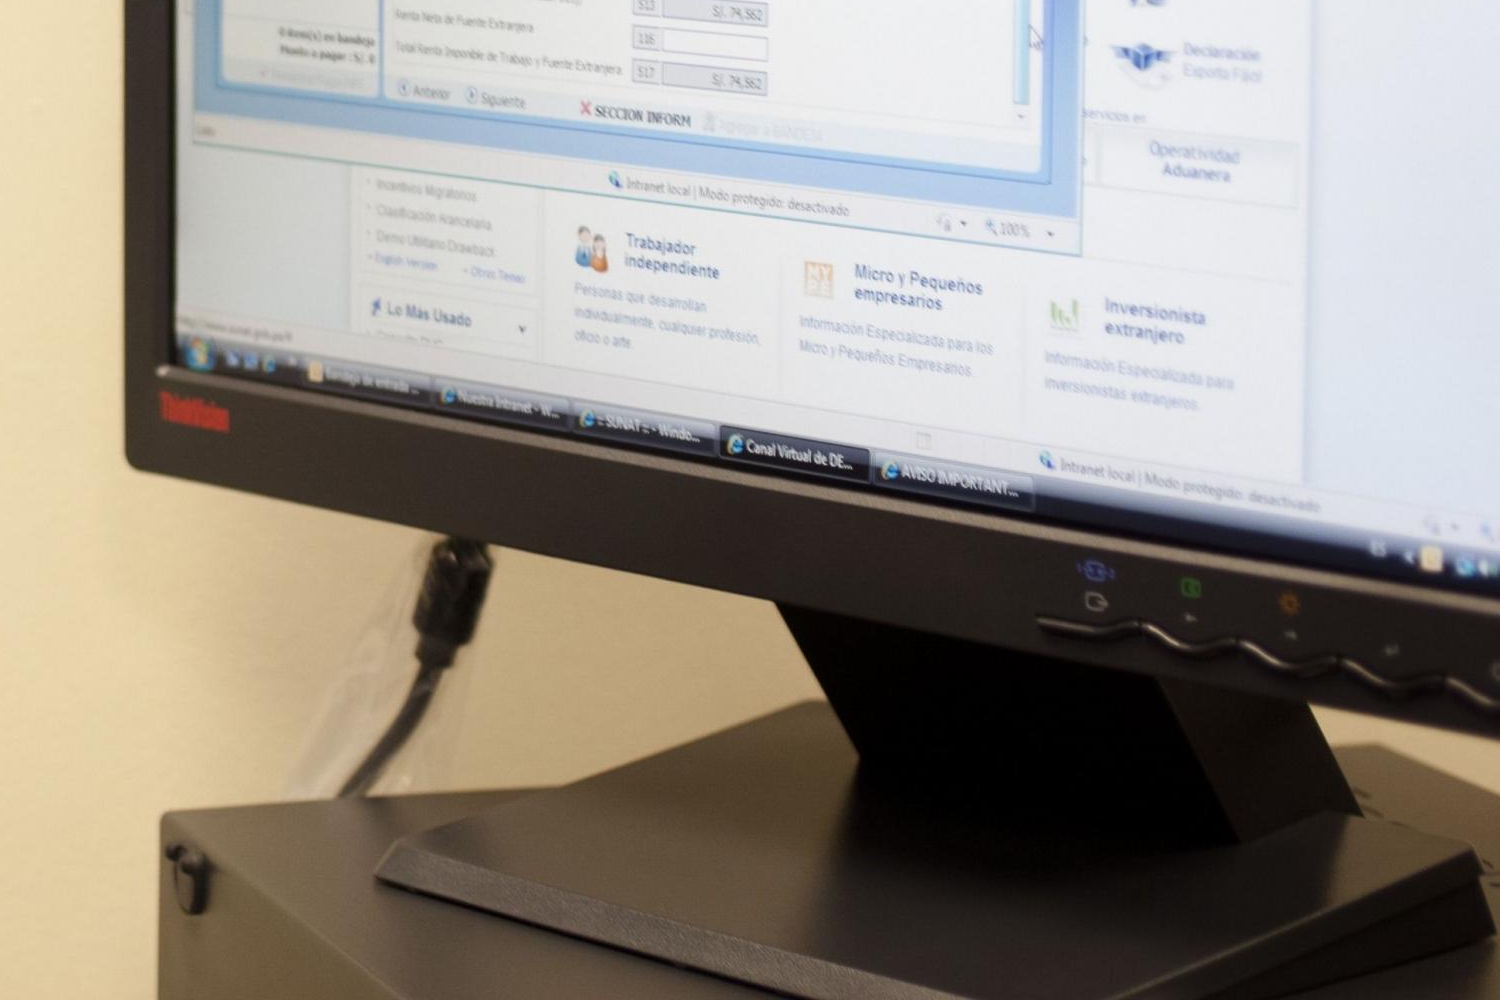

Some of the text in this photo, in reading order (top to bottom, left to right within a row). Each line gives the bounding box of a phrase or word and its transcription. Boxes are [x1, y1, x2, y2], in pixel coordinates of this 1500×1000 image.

[647, 110, 691, 128] INFORM
[1150, 140, 1241, 164] Operatividad
[1162, 163, 1231, 184] Aduanera
[626, 176, 664, 194] Intranet
[667, 183, 691, 198] local
[699, 187, 729, 203] Modo
[788, 198, 849, 218] desactivado
[627, 232, 696, 256] Trabajador
[625, 254, 720, 280] independiente
[855, 264, 894, 283] Micro
[910, 270, 983, 295] Pequeños
[575, 282, 707, 313] Personas que desarrollan
[855, 287, 942, 310] empresarios
[387, 301, 402, 316] Lo
[433, 309, 472, 327] Usado
[1105, 297, 1206, 326] Inversionista
[659, 319, 706, 337] cualquier
[867, 325, 944, 349] Especializada
[948, 338, 972, 355] para
[975, 342, 994, 356] los
[1105, 321, 1185, 345] extranjero
[800, 339, 828, 356] Micro
[1118, 360, 1203, 386] Especializada
[1206, 376, 1234, 391] para
[746, 439, 776, 456] Canal
[778, 444, 812, 464] Virtual
[901, 466, 934, 483] AVISO
[1060, 458, 1104, 478] Intranet
[1108, 468, 1136, 484] local
[1145, 472, 1180, 490] Modo
[1250, 490, 1320, 513] desactivado
